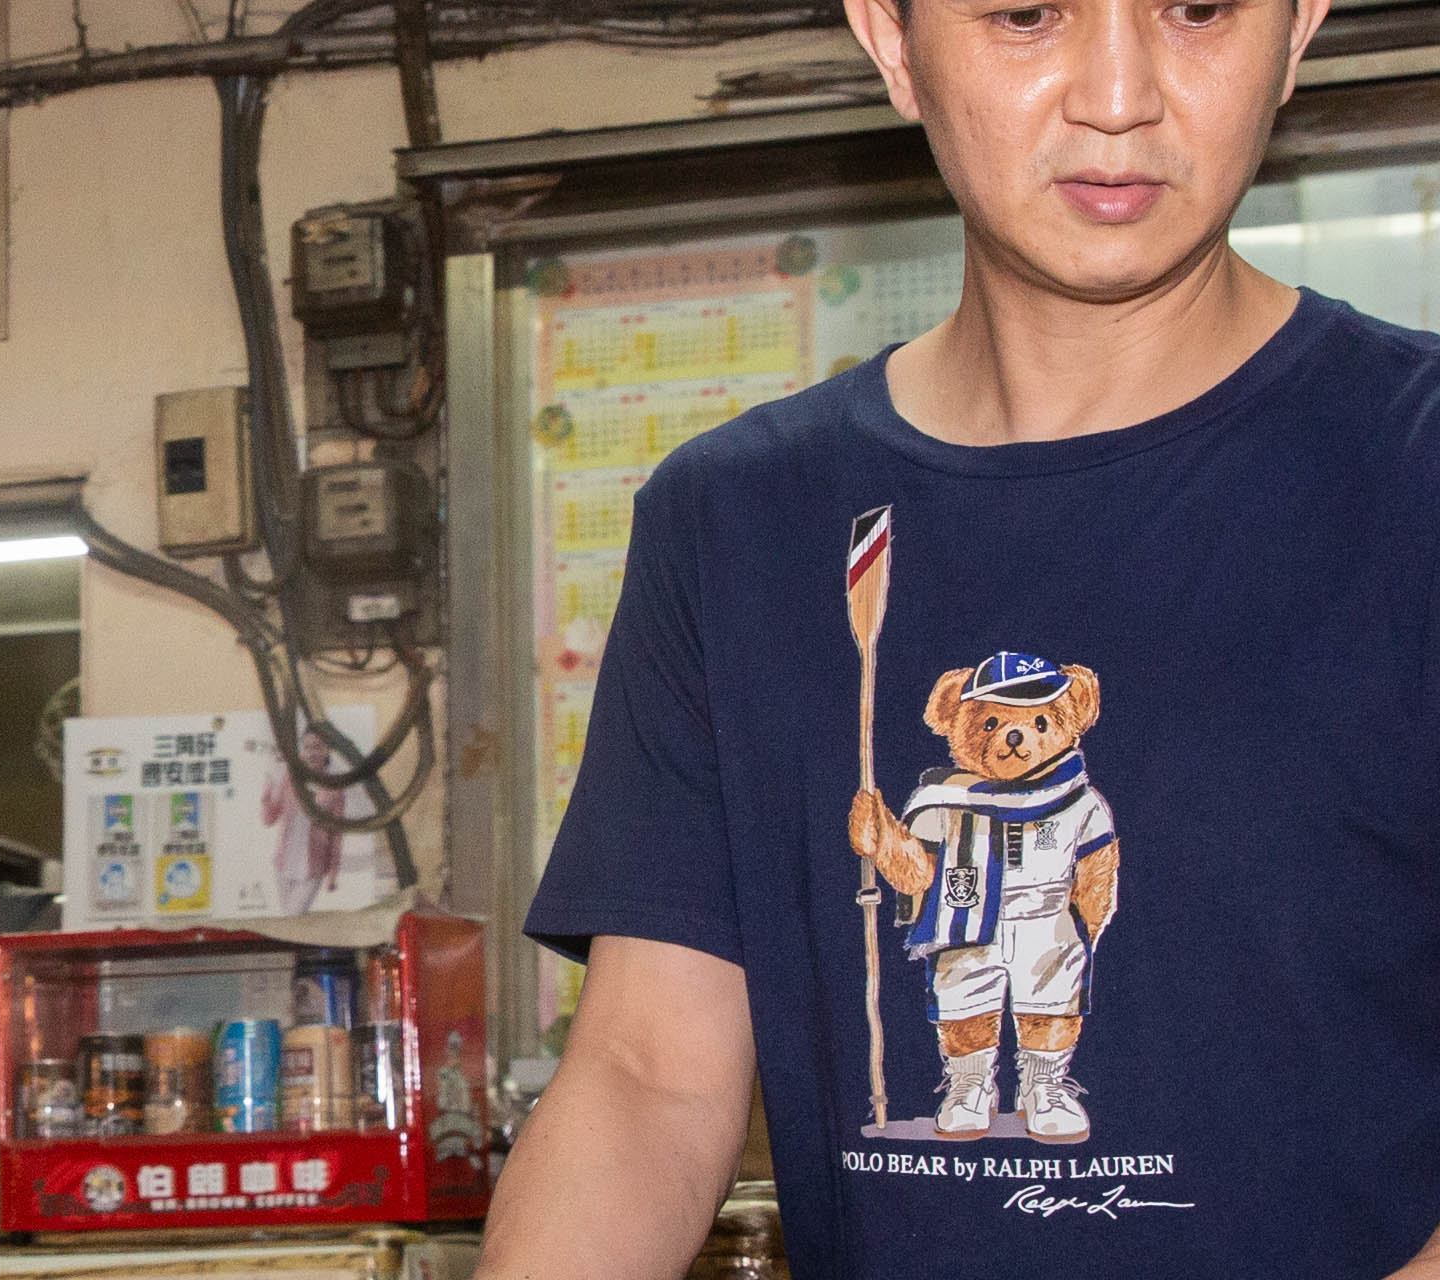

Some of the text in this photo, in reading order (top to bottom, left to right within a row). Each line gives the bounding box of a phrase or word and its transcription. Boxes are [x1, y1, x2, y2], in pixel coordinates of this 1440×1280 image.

[136, 1158, 329, 1200] 伯朗咖啡
[841, 1151, 1176, 1181] POLO BEAR by RALPH LAUREN
